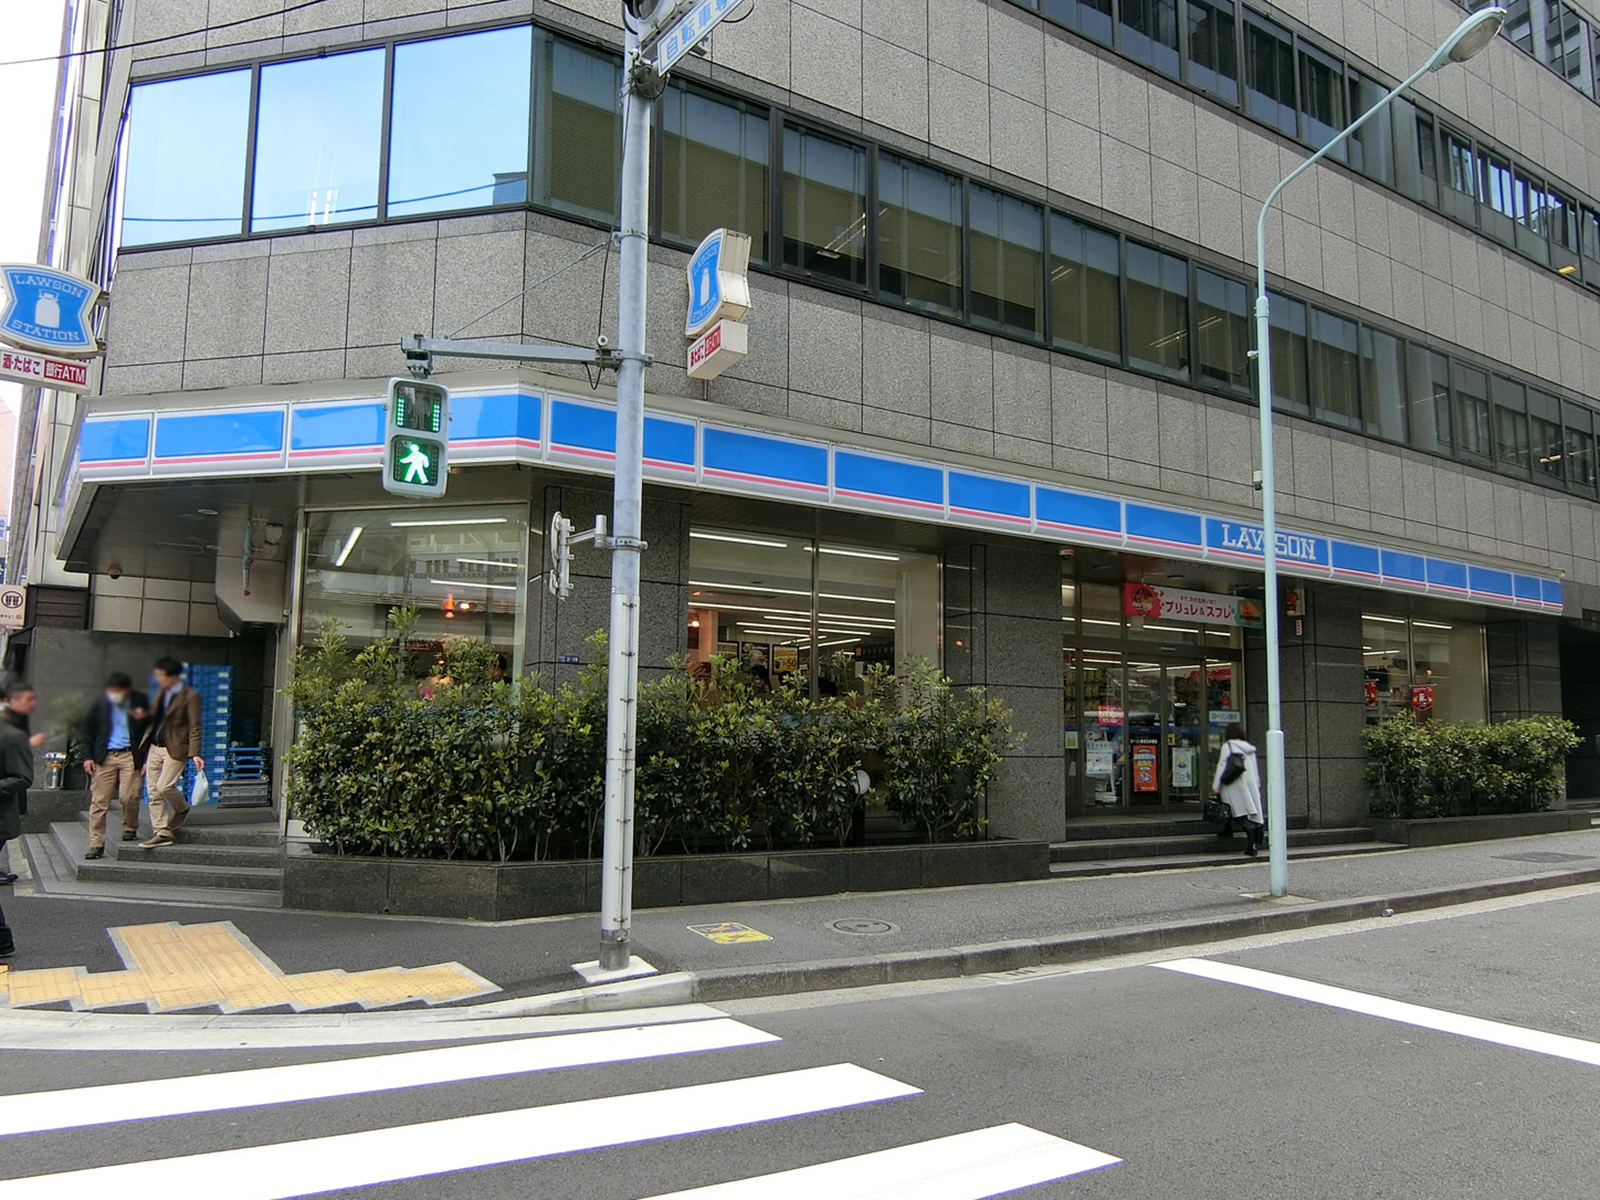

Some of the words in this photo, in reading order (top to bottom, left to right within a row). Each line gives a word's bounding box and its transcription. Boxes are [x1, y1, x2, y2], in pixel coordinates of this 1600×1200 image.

[14, 275, 84, 298] LAWSON
[12, 319, 80, 341] STATION
[46, 362, 85, 383] 銀行ATM
